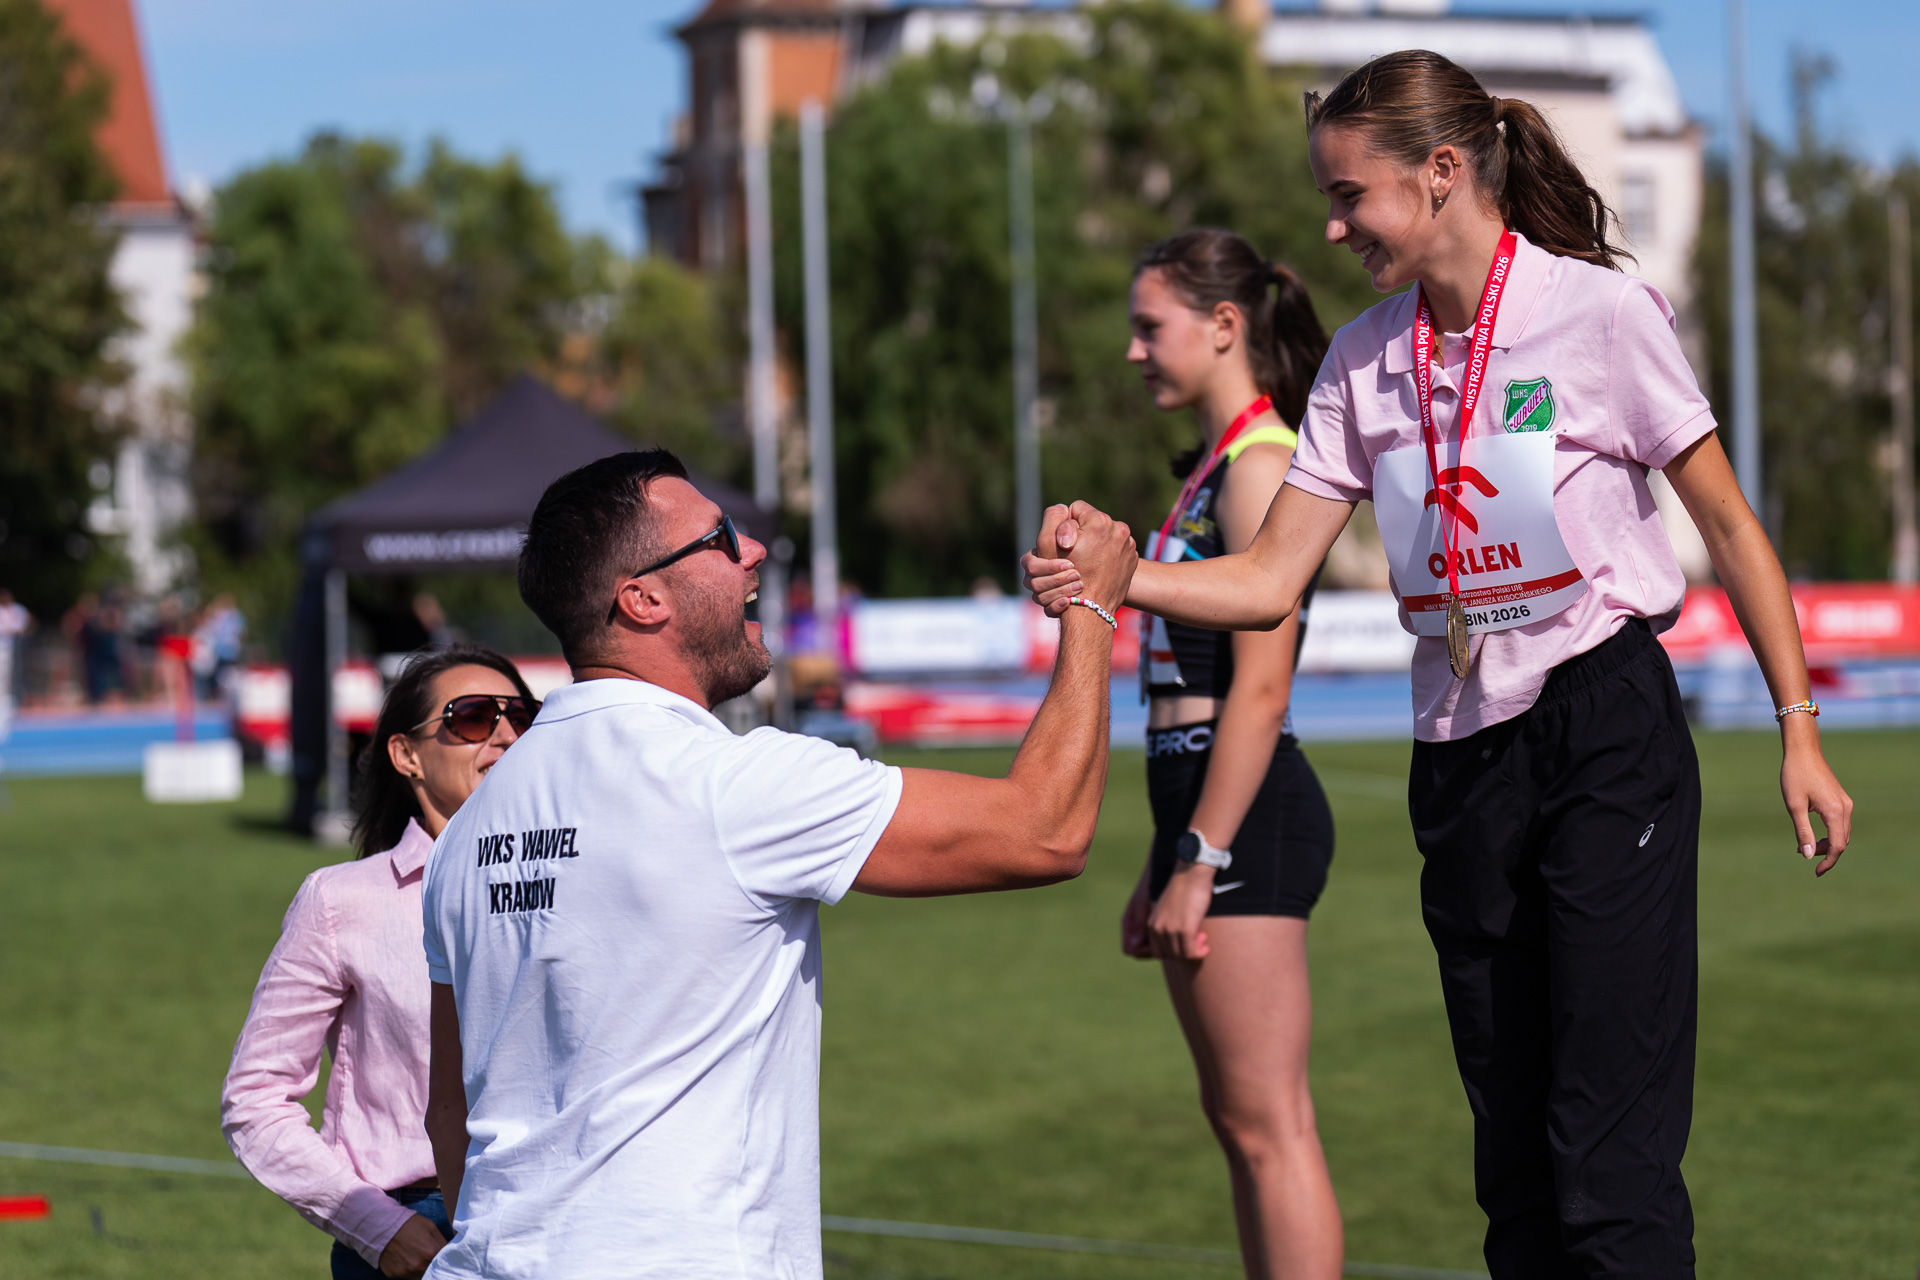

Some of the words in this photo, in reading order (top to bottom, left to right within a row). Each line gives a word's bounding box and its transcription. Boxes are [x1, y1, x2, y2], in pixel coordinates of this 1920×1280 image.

[1465, 327, 1490, 409] MISTRZOSTWA
[1480, 284, 1501, 325] POLSKI
[1492, 255, 1510, 283] 2026
[1417, 346, 1431, 427] MISTRZOSTWA
[1470, 596, 1497, 606] JANUSZA
[1497, 586, 1553, 603] KUSOCIŃSKIEGO
[1492, 586, 1510, 595] Polski
[1511, 584, 1523, 592] U16
[1491, 604, 1531, 622] 2026
[478, 833, 515, 868] WKS
[521, 828, 579, 862] WAWEL
[489, 869, 556, 914] KRAKÓW
